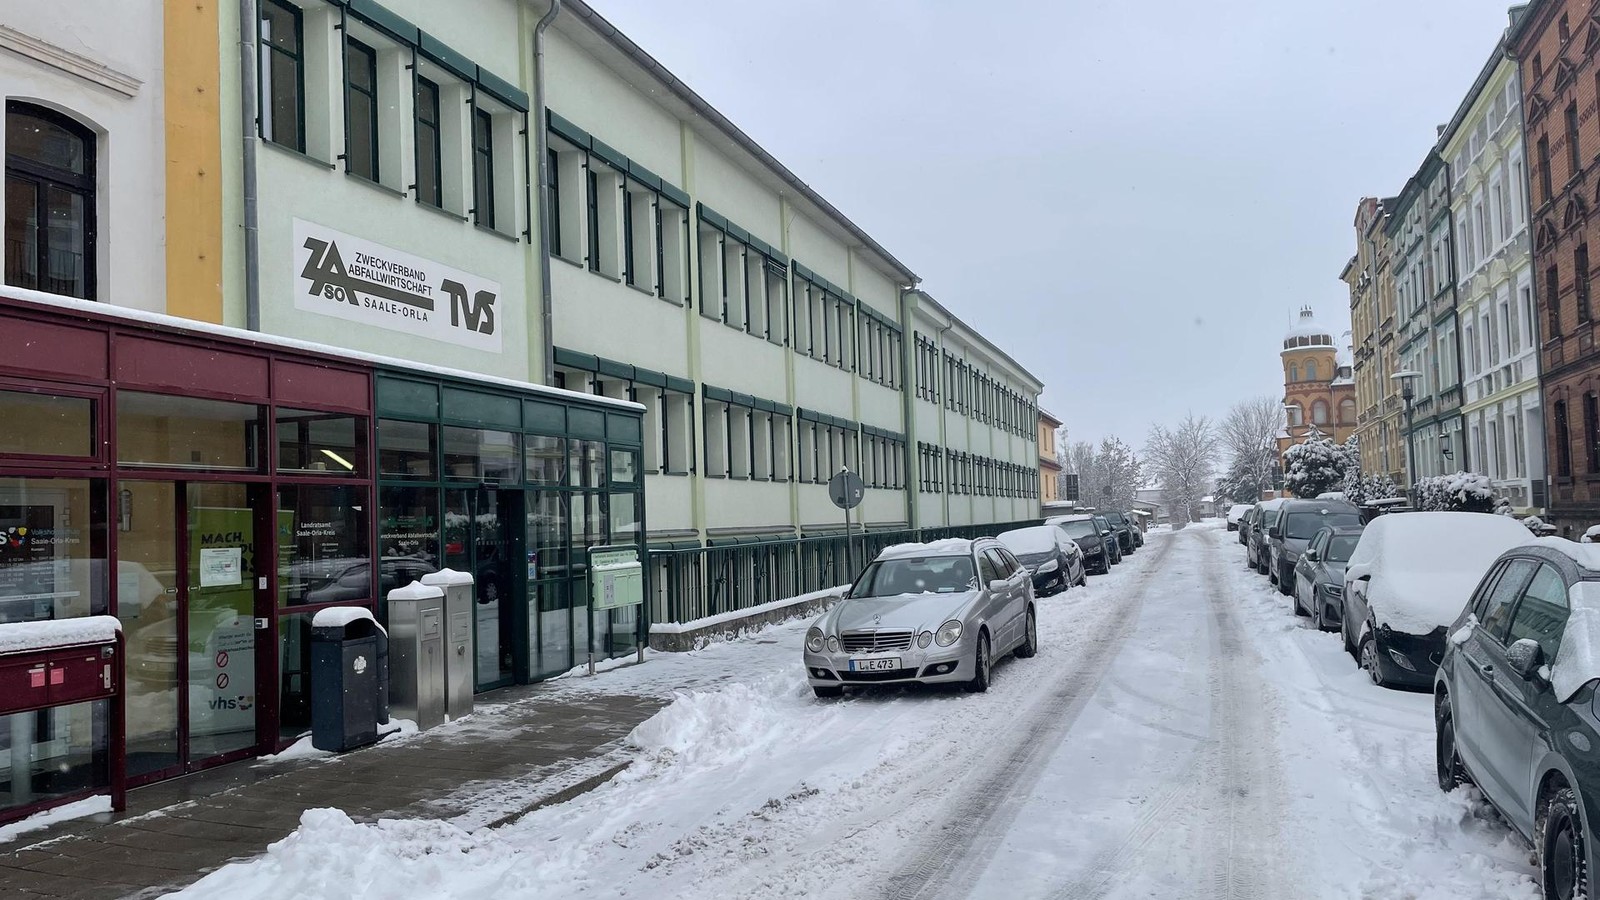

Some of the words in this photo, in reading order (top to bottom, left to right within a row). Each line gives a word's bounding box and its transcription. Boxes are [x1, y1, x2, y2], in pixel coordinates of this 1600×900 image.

[348, 263, 432, 296] ABFALLWIRTSCHAFT
[355, 252, 426, 282] ZWECKVERBAND
[364, 297, 429, 322] SAALE-ORLA
[440, 278, 497, 335] TVS
[877, 660, 894, 669] 473
[208, 697, 237, 710] vhs
